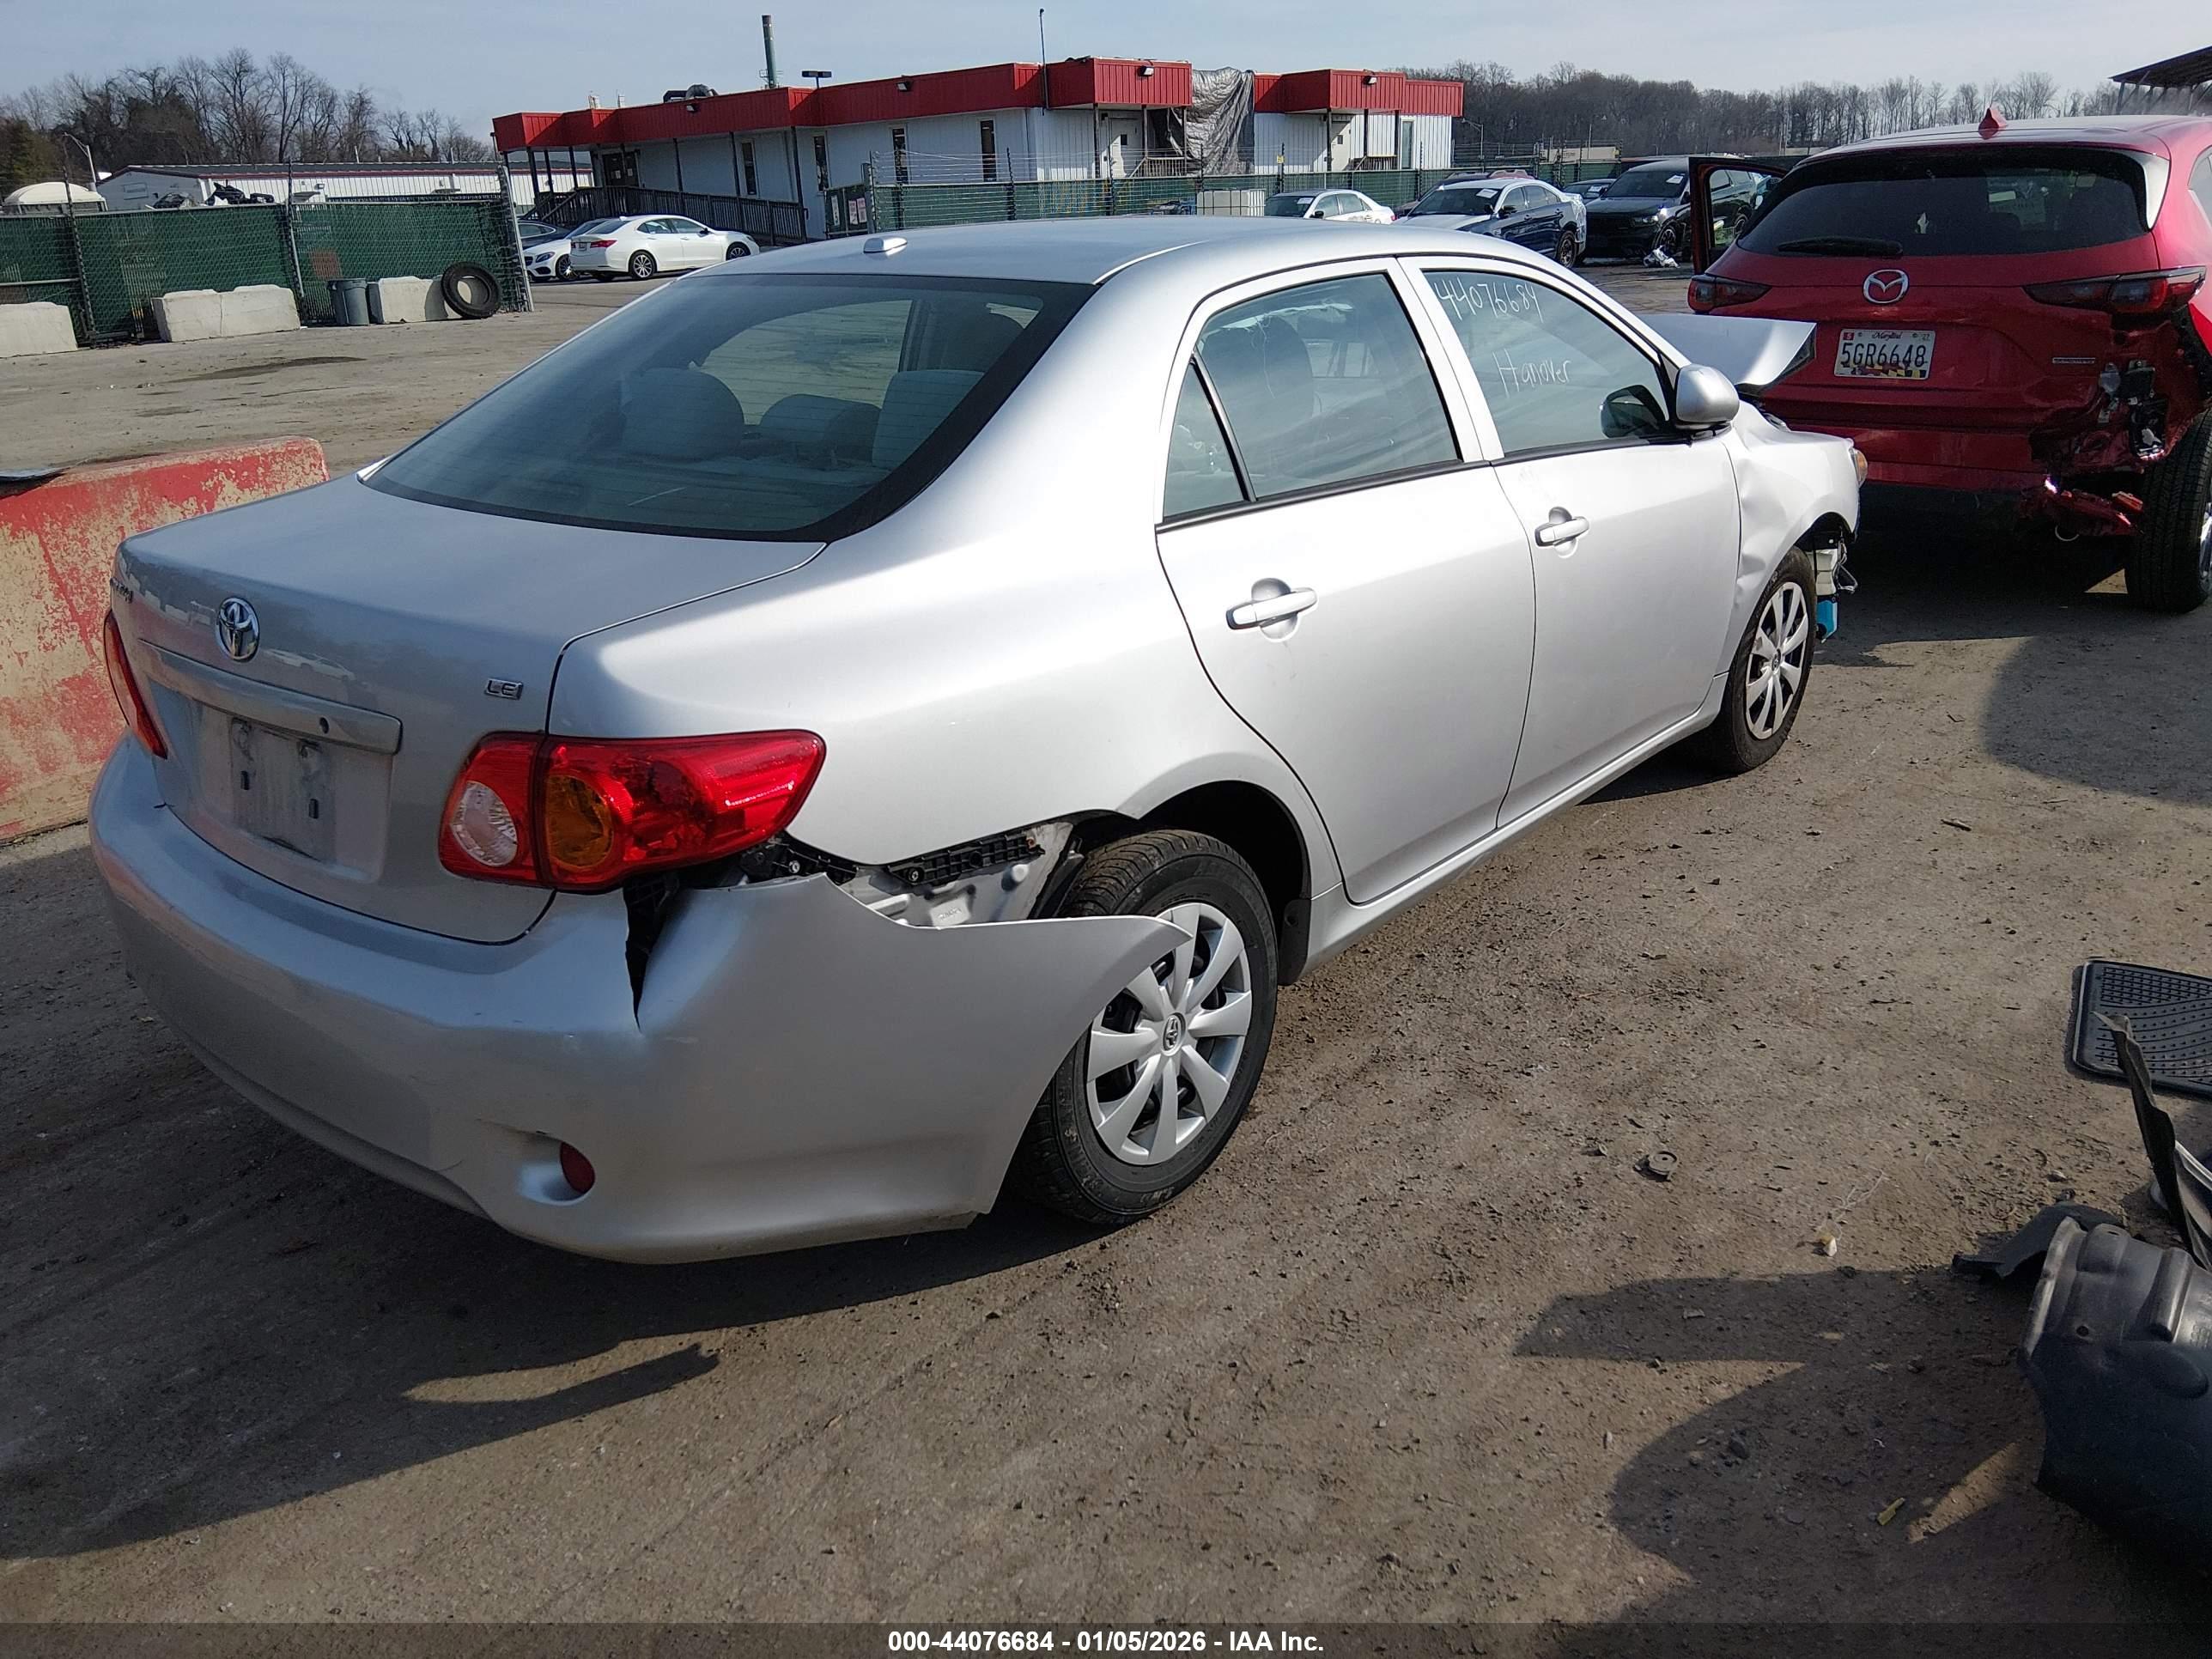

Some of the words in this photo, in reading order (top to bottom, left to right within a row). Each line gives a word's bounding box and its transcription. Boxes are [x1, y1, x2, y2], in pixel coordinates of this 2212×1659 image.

[1434, 276, 1544, 324] 44076684
[1492, 348, 1571, 398] Hanover
[1840, 343, 1927, 368] 5GR6648
[487, 678, 519, 697] LE
